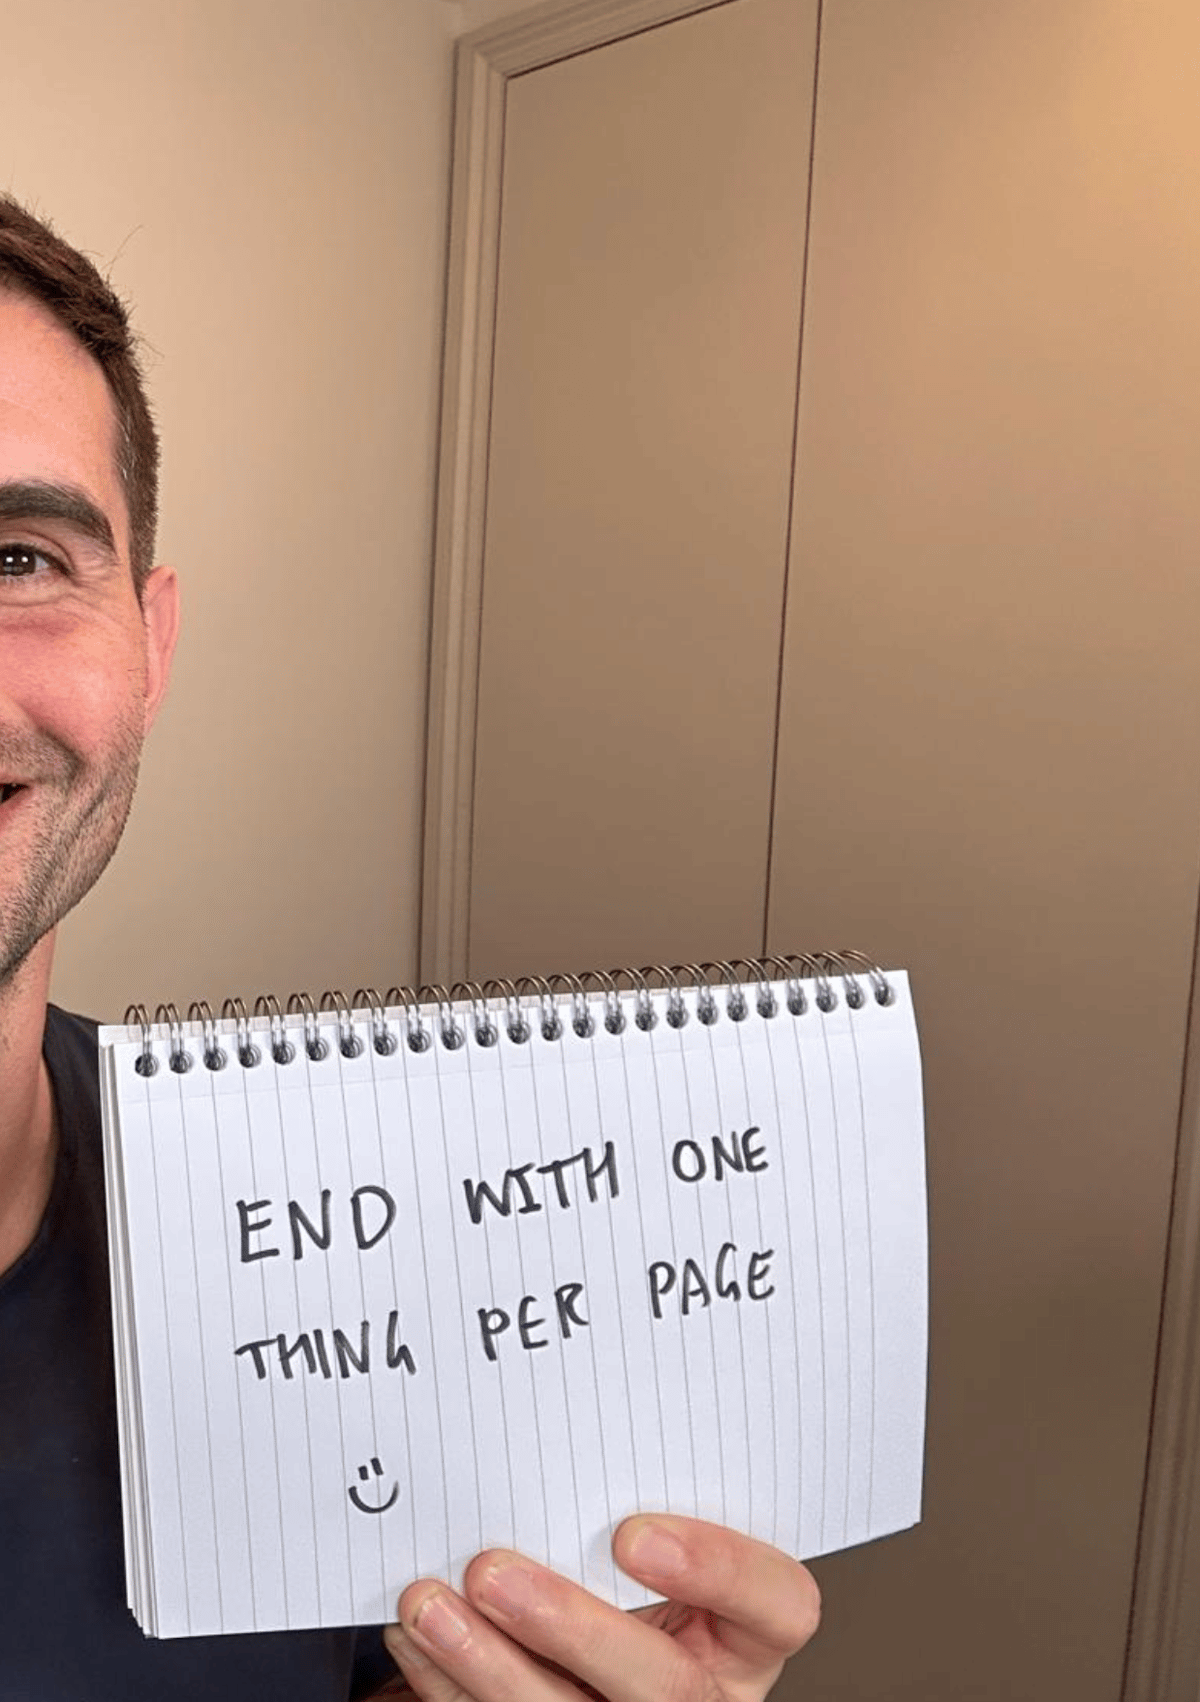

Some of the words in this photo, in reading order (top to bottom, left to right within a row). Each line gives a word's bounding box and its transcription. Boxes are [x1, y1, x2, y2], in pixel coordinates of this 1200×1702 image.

[236, 1184, 397, 1263] END
[463, 1141, 619, 1224] WITH
[672, 1126, 769, 1182] ONE
[234, 1310, 417, 1380] THING
[477, 1282, 590, 1361] PER
[648, 1242, 775, 1319] PAGE
